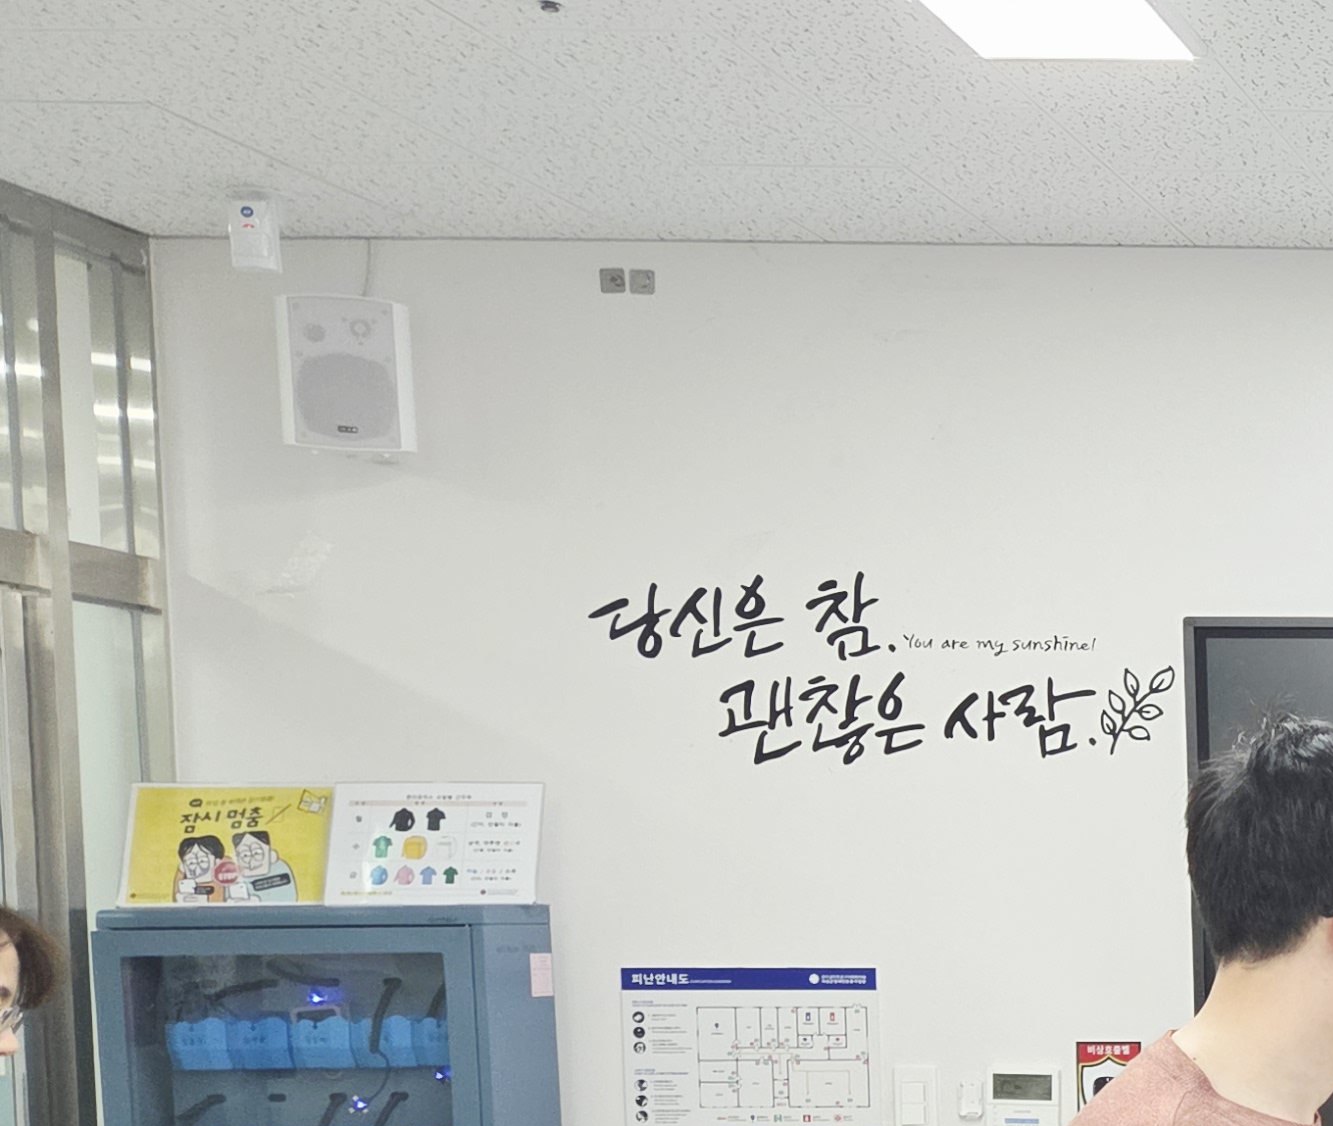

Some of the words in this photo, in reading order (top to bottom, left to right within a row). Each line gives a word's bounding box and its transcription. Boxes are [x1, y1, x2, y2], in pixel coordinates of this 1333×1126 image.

[588, 575, 785, 659] 당신은
[805, 571, 897, 660] 참.
[903, 634, 933, 652] You
[941, 637, 970, 650] are
[975, 637, 1008, 656] my
[1012, 635, 1098, 653] sunshine!
[718, 672, 926, 765] 괜찮은
[944, 677, 1097, 758] 사람.
[180, 811, 221, 833] 잠시
[227, 807, 263, 829] 멈춤
[631, 973, 689, 985] 피난안내도
